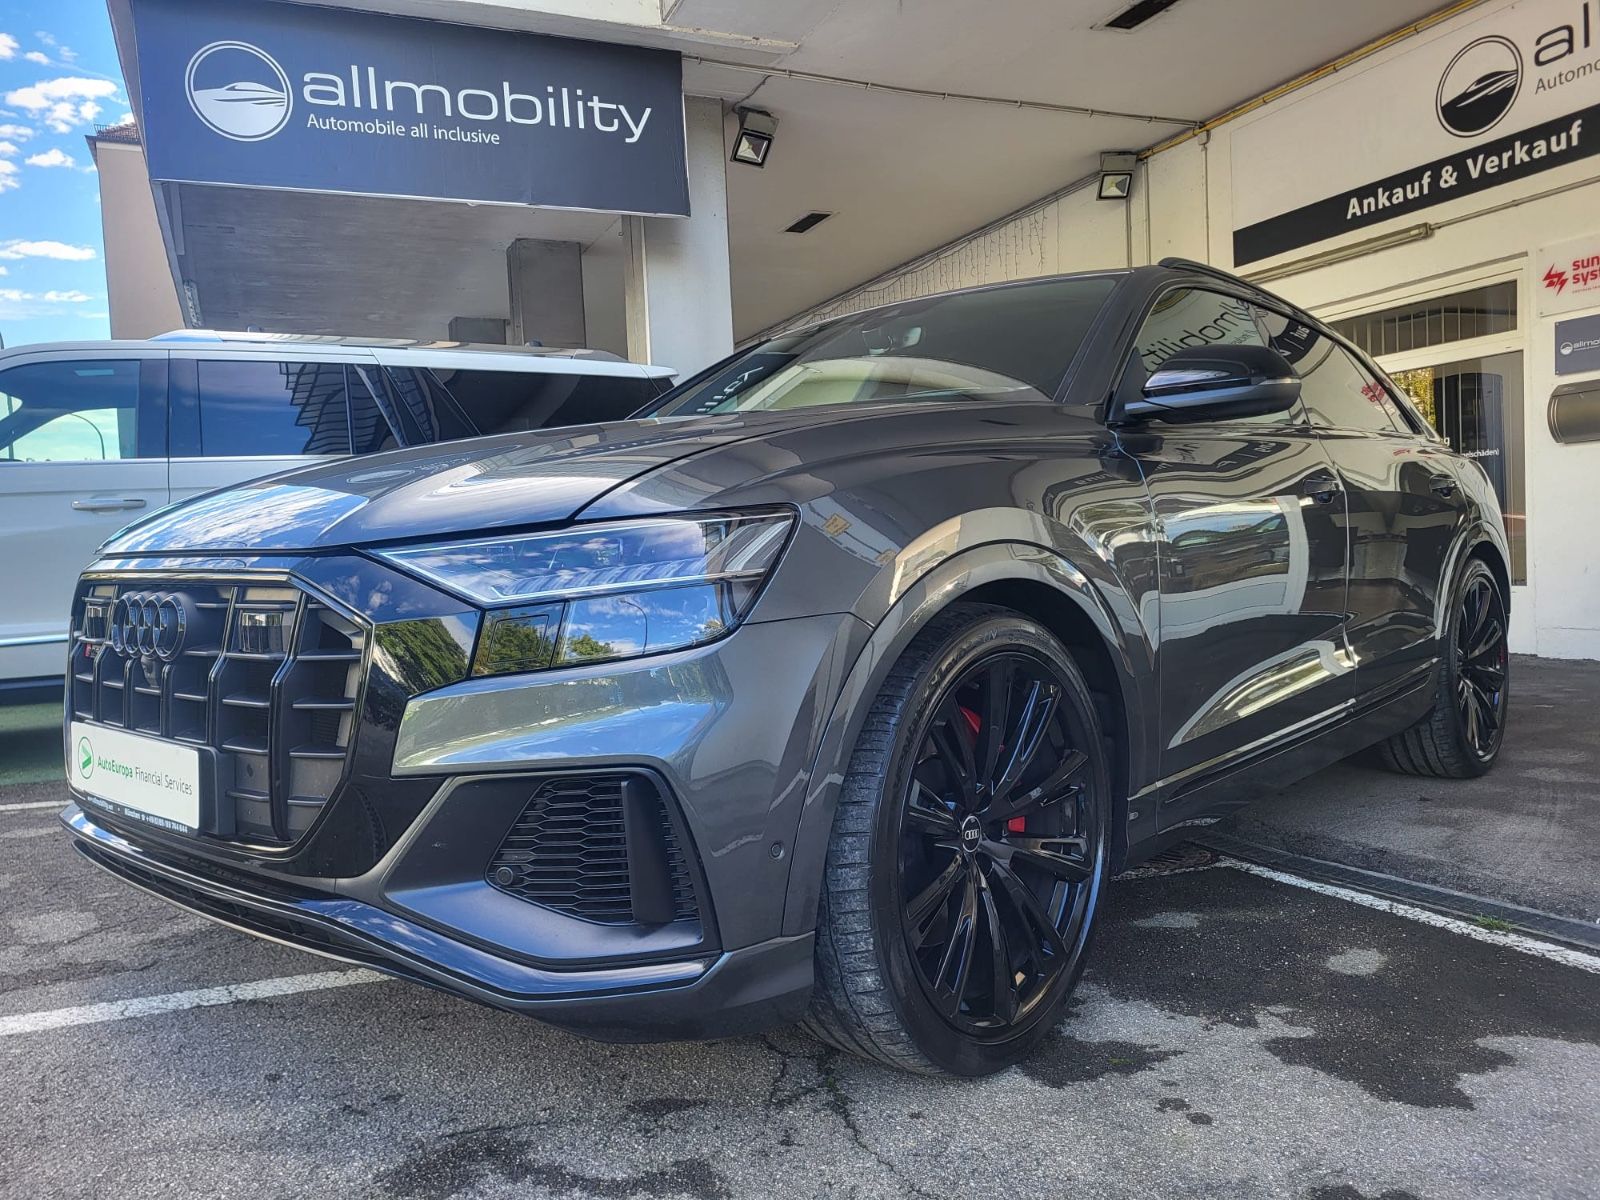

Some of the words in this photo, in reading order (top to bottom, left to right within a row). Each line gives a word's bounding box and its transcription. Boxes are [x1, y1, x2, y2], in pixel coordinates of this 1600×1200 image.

[1534, 2, 1600, 67] al
[302, 64, 652, 143] allmobility
[306, 114, 406, 137] Automobile
[411, 122, 429, 138] all
[433, 126, 501, 145] inclusive
[1346, 172, 1431, 219] Ankauf
[1439, 165, 1458, 188] &
[1465, 119, 1583, 180] Verkauf
[97, 755, 133, 779] AutoEuropa
[135, 766, 163, 787] Financial
[164, 774, 193, 796] Services
